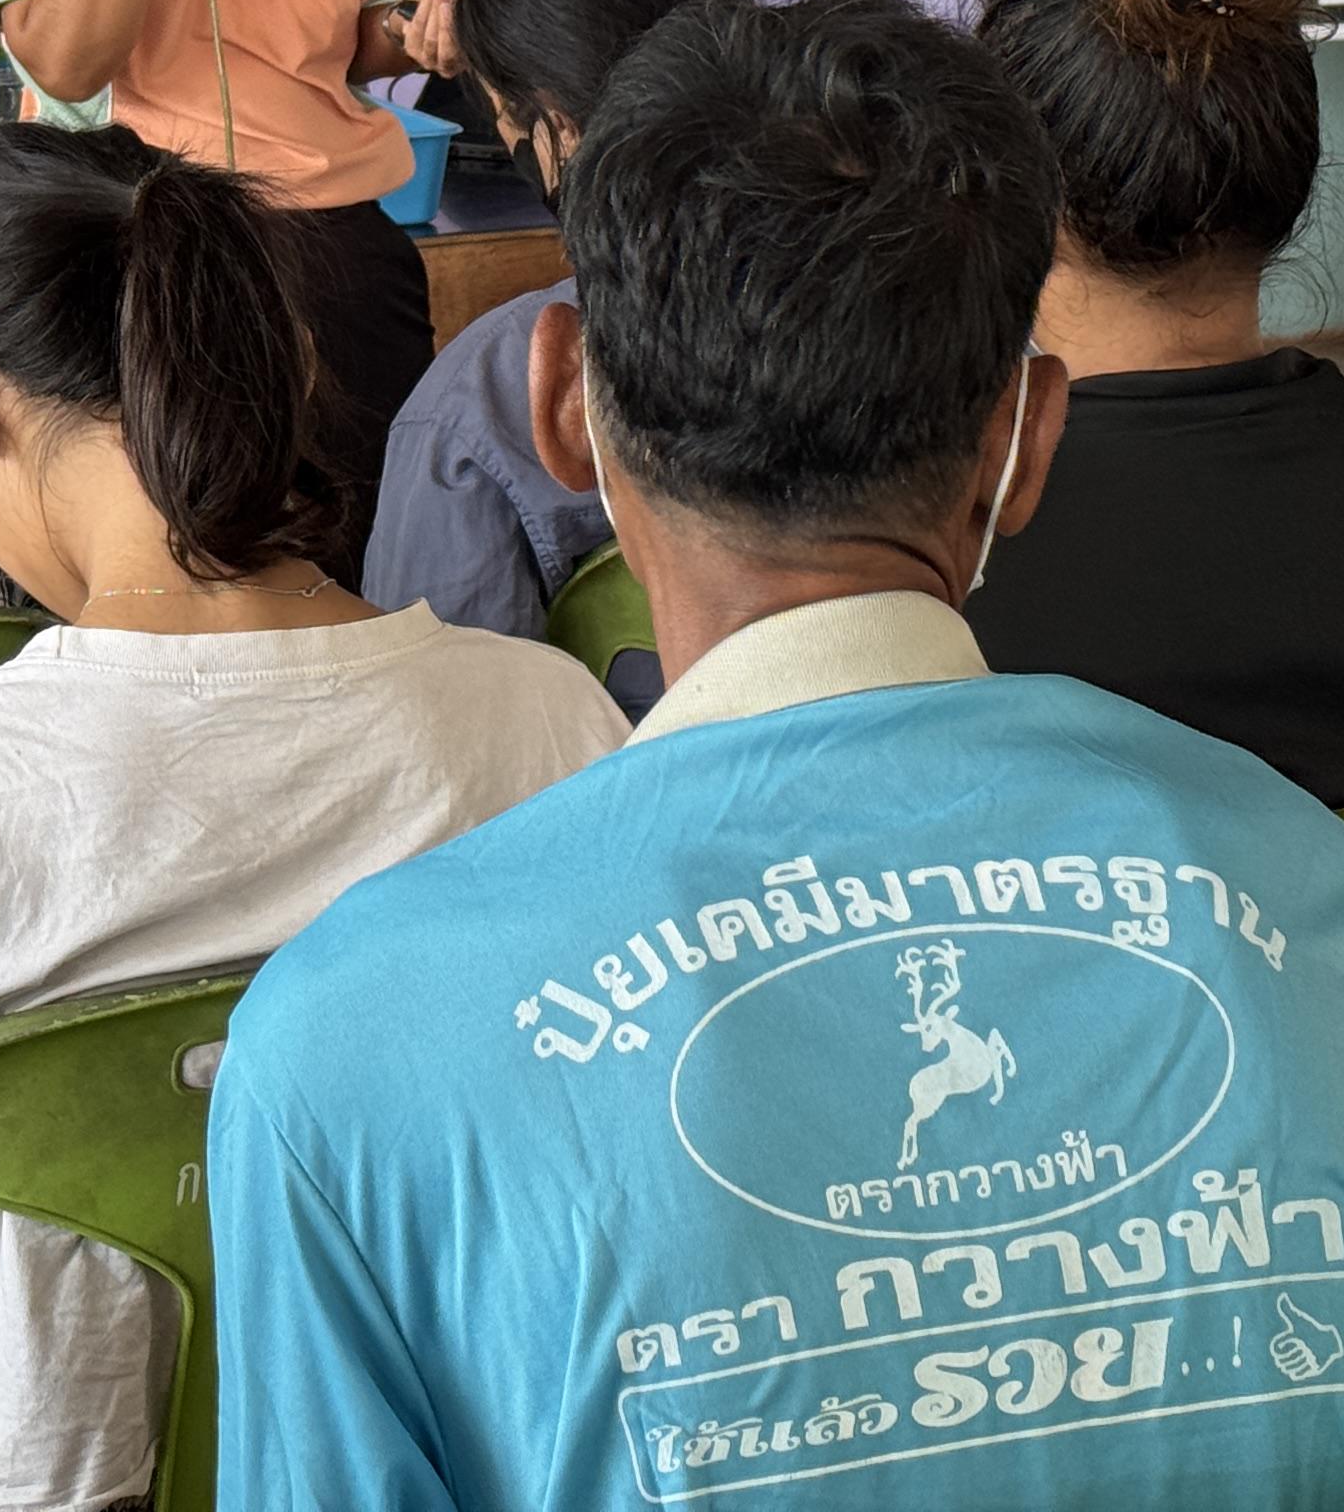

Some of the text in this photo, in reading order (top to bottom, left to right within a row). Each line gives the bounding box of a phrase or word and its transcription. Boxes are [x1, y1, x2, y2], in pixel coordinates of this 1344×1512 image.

[514, 853, 1288, 1064] ปุ๋ยเคมีมาตรฐาน
[824, 1130, 1129, 1220] ตรากวางฟ้า
[617, 1293, 799, 1376] ตรา
[646, 1392, 900, 1476] ใช้แล้ว
